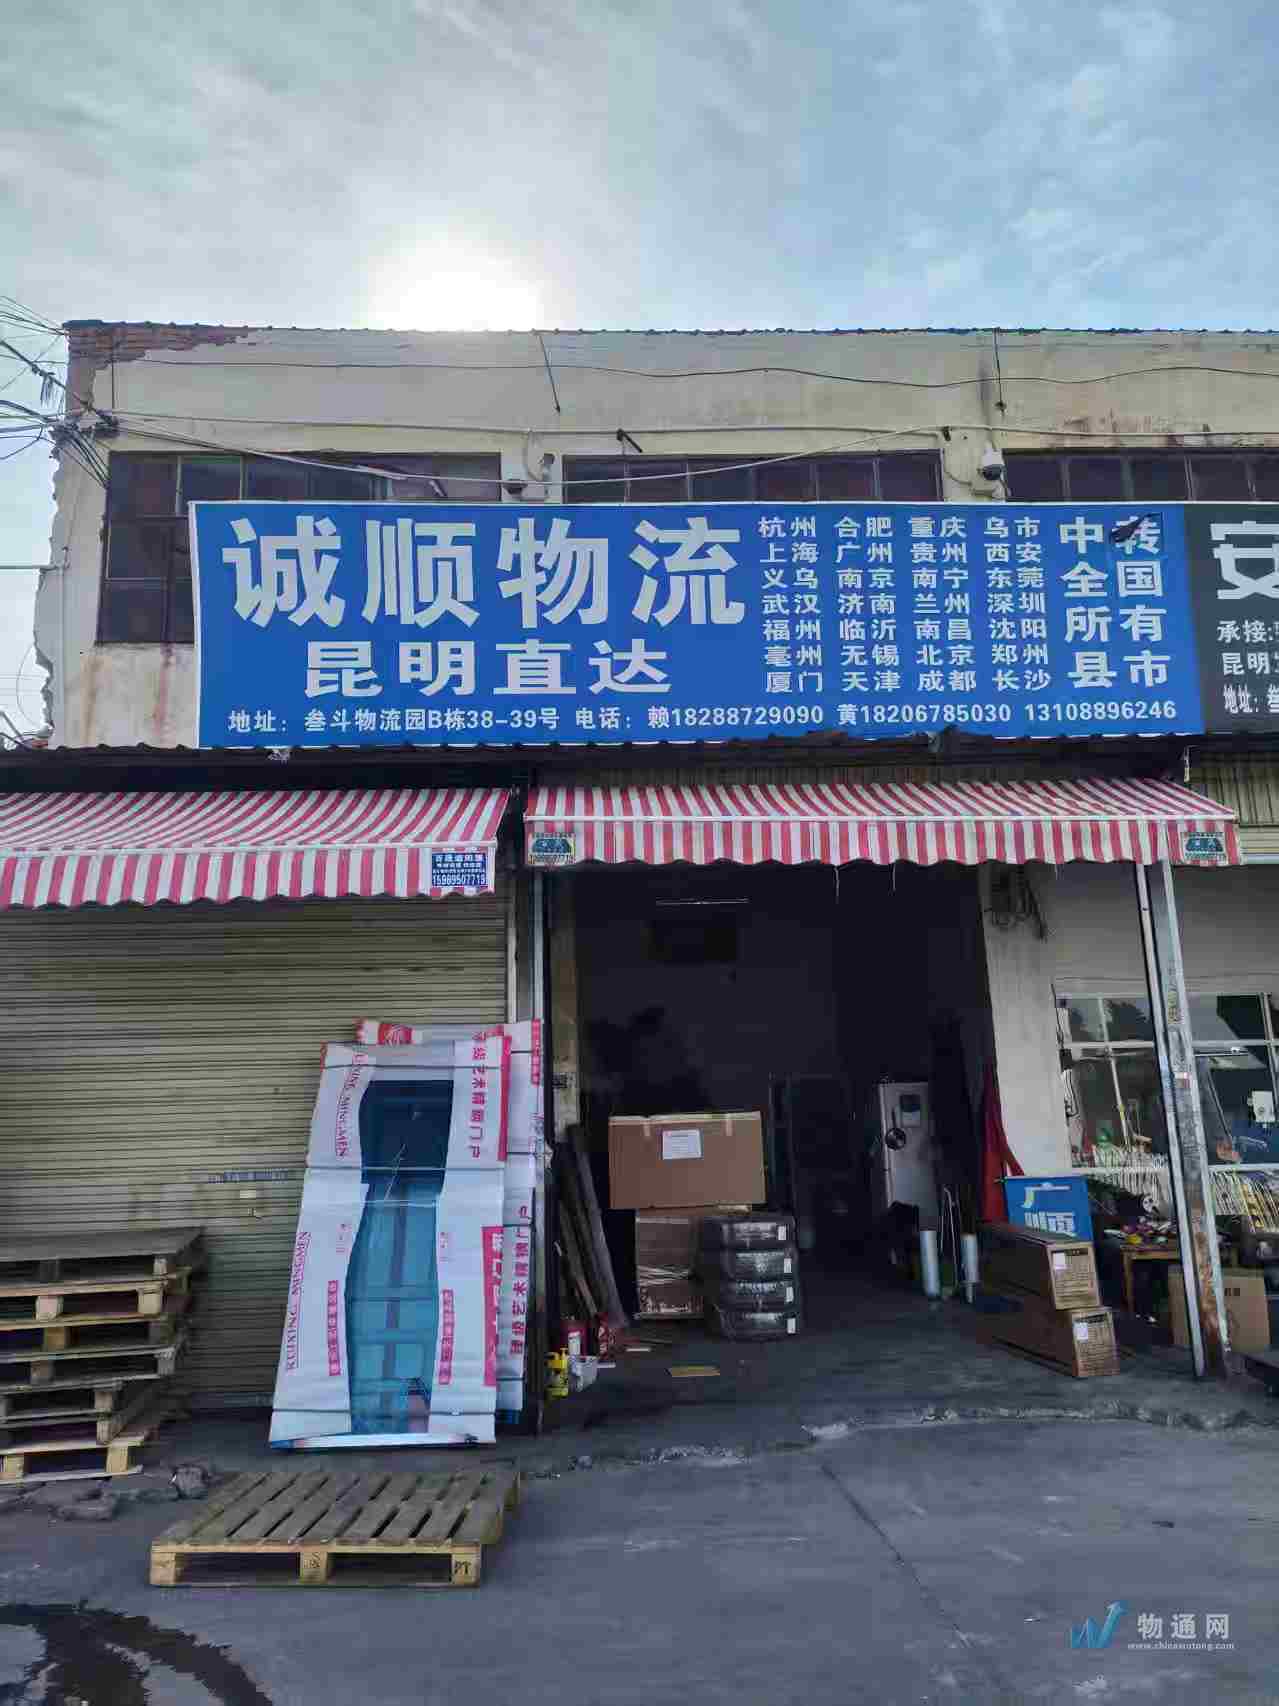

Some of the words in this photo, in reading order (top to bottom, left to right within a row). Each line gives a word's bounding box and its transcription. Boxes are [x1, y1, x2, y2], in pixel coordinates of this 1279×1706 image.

[758, 516, 816, 538] 杭州
[835, 516, 893, 538] 合肥
[908, 516, 966, 538] 重庆
[983, 516, 1041, 538] 乌市
[759, 542, 819, 563] 上海
[836, 542, 892, 563] 广州
[910, 542, 967, 564] 贵州
[983, 542, 1041, 563] 西安
[222, 515, 745, 629] 诚顺物流
[762, 567, 818, 589] 义乌
[836, 567, 895, 589] 南京
[911, 567, 969, 589] 南宁
[986, 566, 1044, 589] 东莞
[1060, 560, 1163, 597] 全国
[762, 593, 821, 615] 武汉
[838, 592, 897, 615] 济南
[913, 593, 970, 614] 兰州
[987, 591, 1046, 614] 深圳
[762, 619, 821, 641] 福州
[839, 618, 897, 641] 临沂
[913, 618, 971, 641] 南昌
[989, 617, 1047, 640] 沈阳
[1064, 605, 1167, 642] 所有
[1216, 619, 1279, 643] 承接:
[841, 644, 899, 666] 无锡
[916, 644, 974, 666] 北京
[991, 643, 1049, 665] 郑州
[1221, 652, 1279, 676] 昆明
[304, 638, 671, 697] 昆明直达
[1068, 650, 1171, 689] 县市
[766, 671, 823, 693] 厦门
[843, 670, 901, 692] 天津
[917, 669, 977, 692] 成都
[991, 668, 1051, 691] 长沙
[836, 703, 1011, 725] 黄18206785030
[1025, 700, 1177, 721] 13108896246
